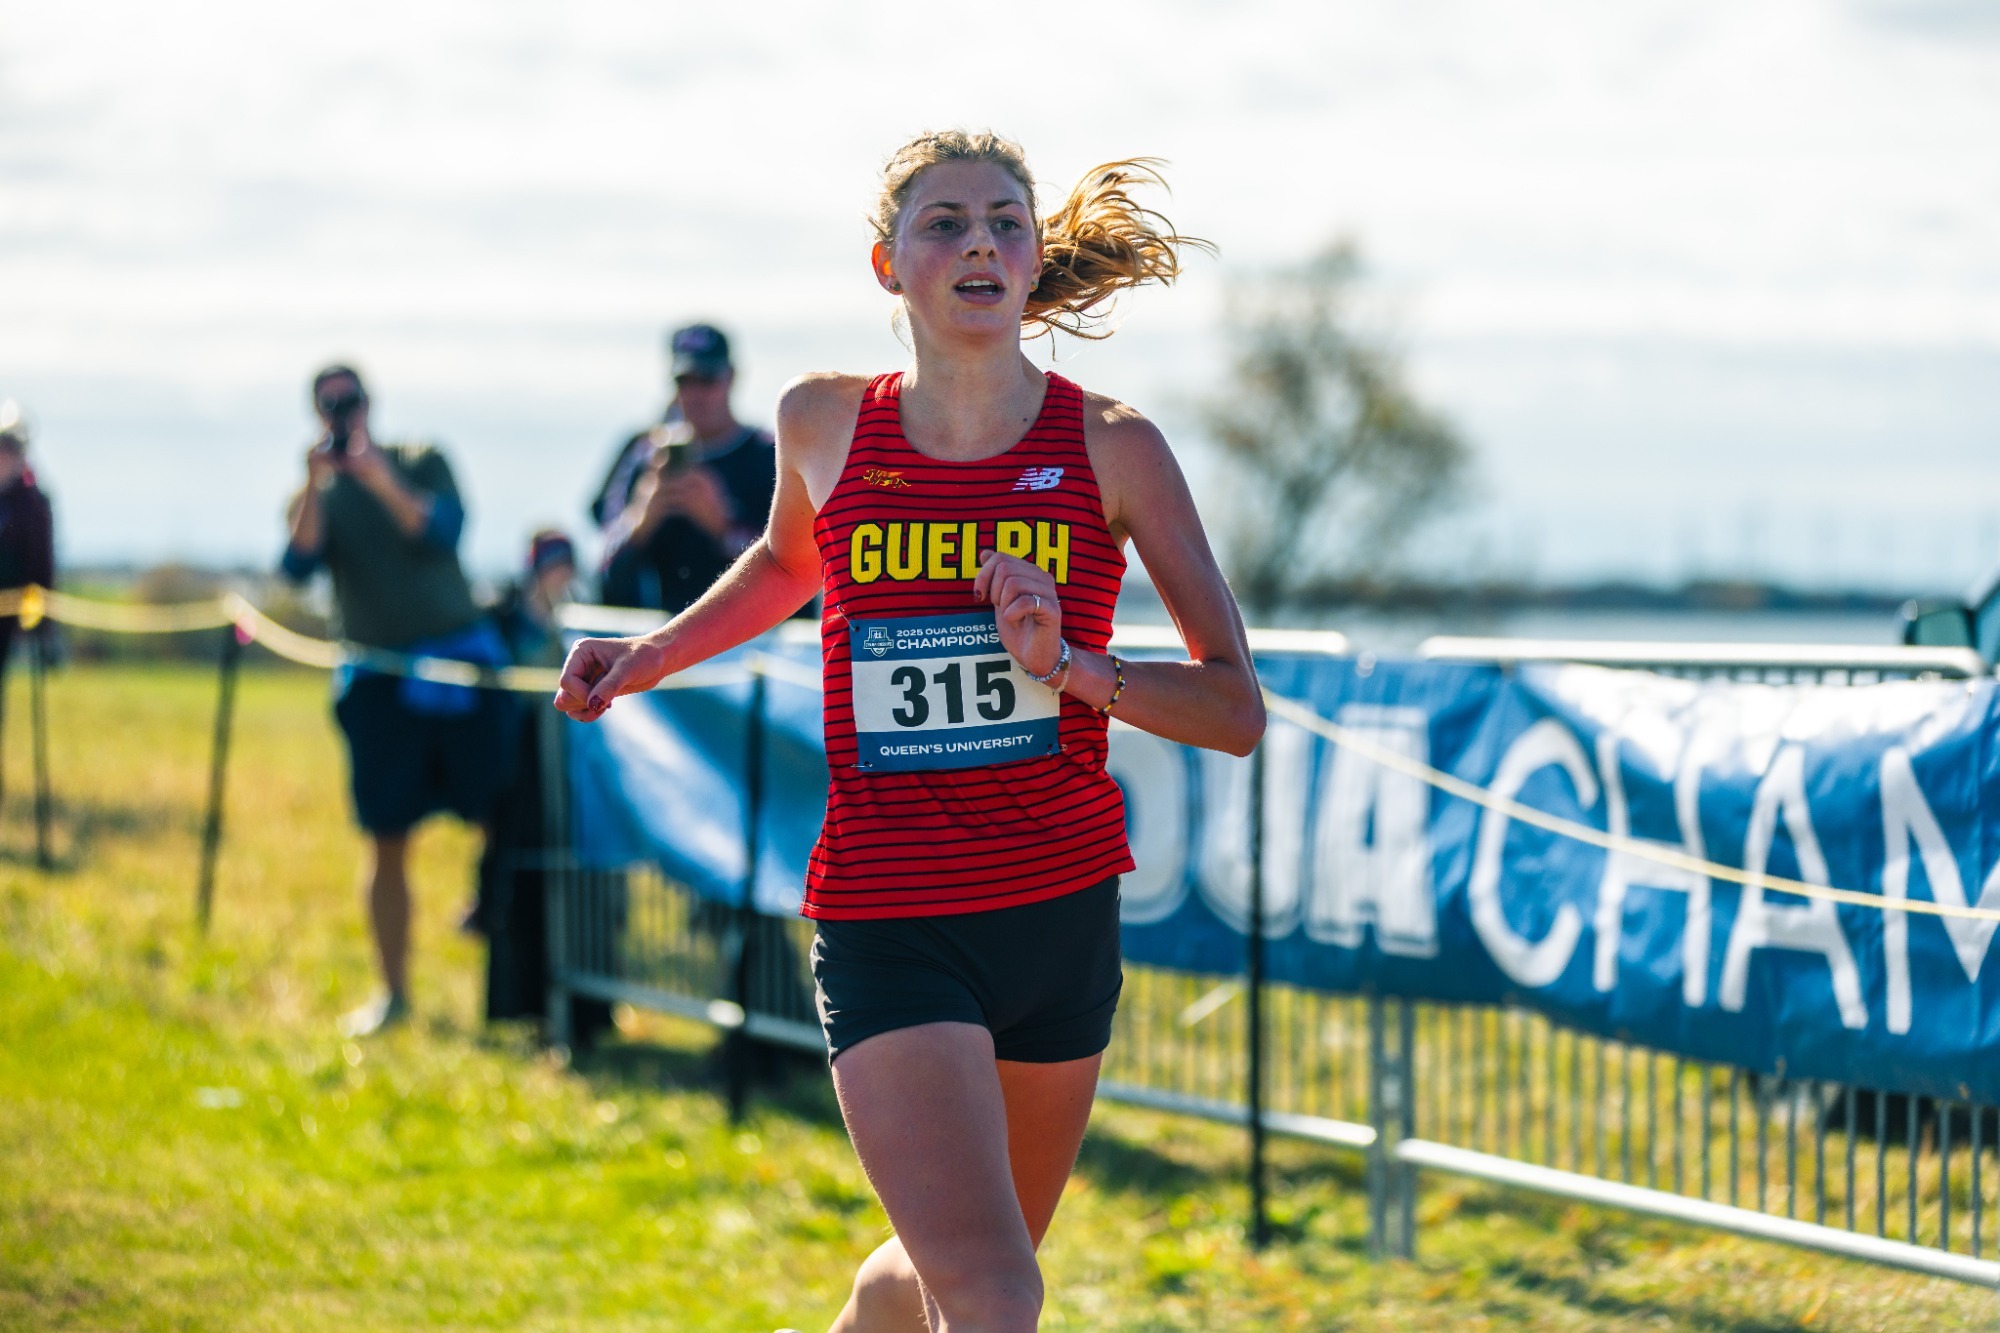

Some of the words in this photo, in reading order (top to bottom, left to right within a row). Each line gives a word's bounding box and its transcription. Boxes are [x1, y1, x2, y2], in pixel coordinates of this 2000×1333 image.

[850, 520, 1071, 585] GUELPH
[896, 629, 923, 637] 2025
[926, 627, 948, 635] OUA
[950, 624, 986, 634] CROSS
[890, 659, 1016, 728] 315
[879, 743, 943, 757] QUEEN'S
[946, 734, 1034, 753] UNIVERSITY
